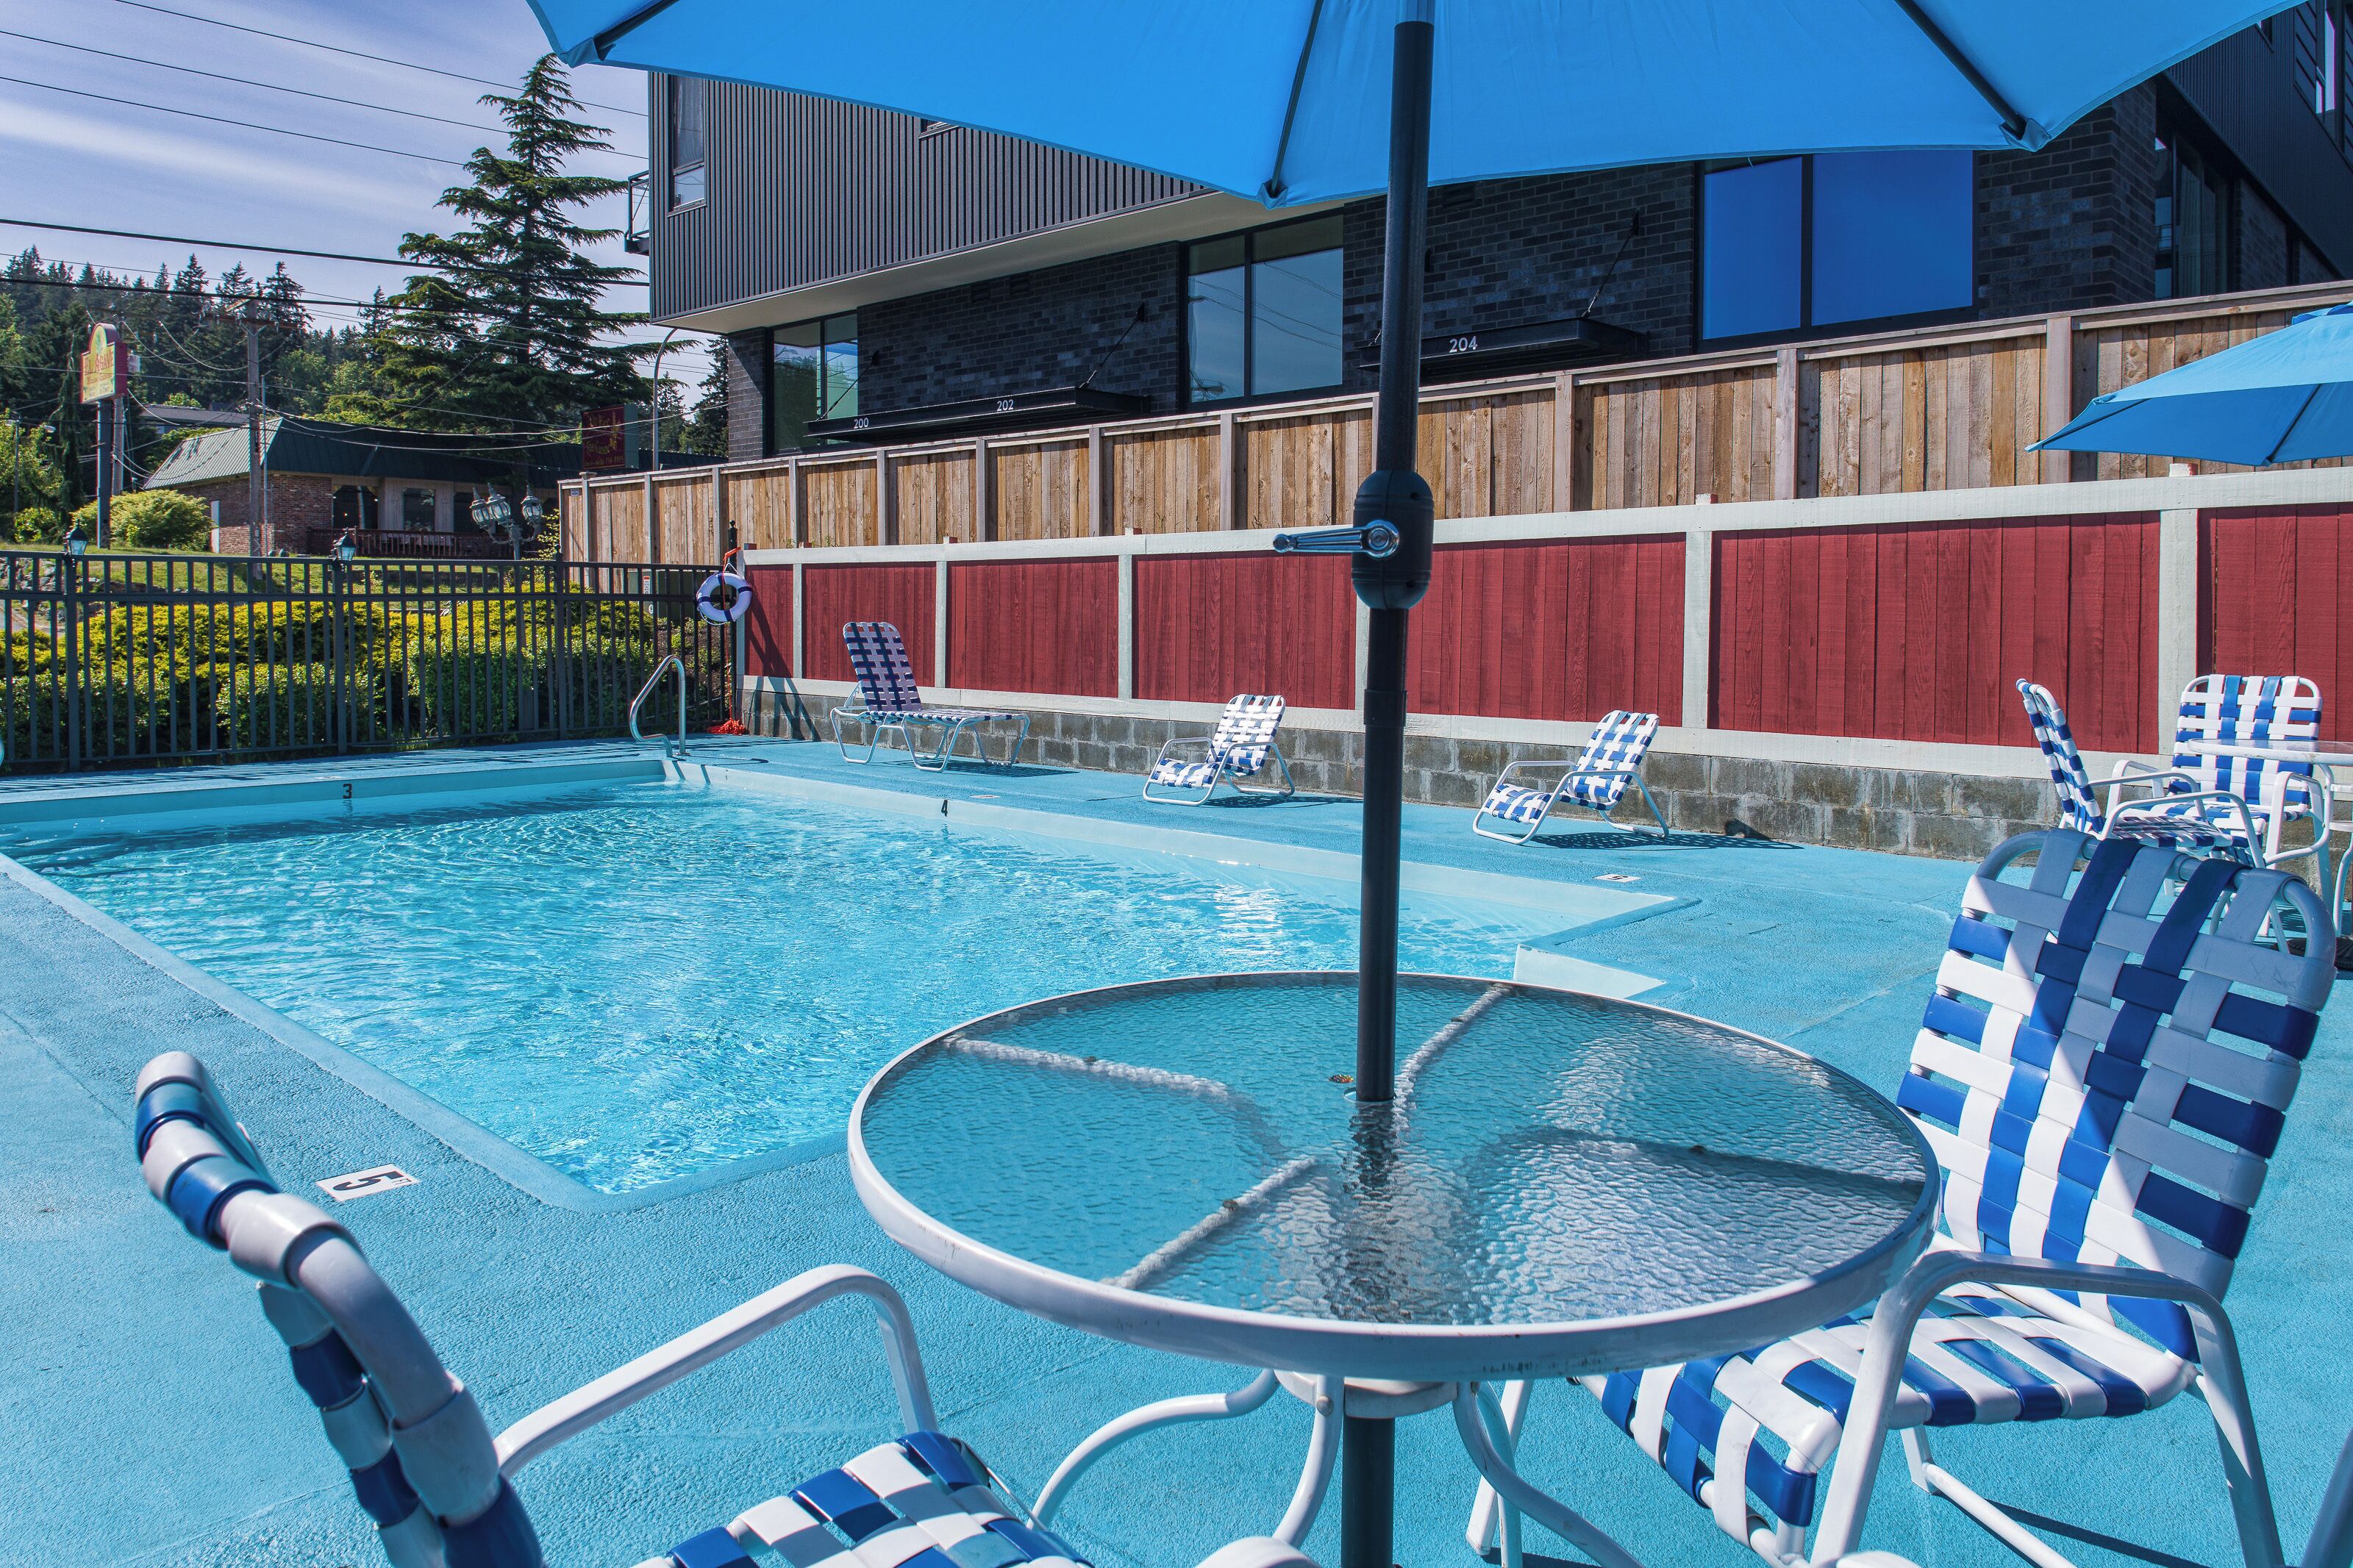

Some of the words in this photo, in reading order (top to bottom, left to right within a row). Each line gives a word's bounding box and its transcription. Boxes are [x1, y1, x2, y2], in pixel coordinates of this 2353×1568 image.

[1449, 336, 1478, 353] 204
[996, 399, 1014, 412] 202
[854, 417, 869, 429] 200
[343, 783, 352, 799] 3
[941, 799, 948, 817] 4
[332, 1170, 404, 1191] 5
